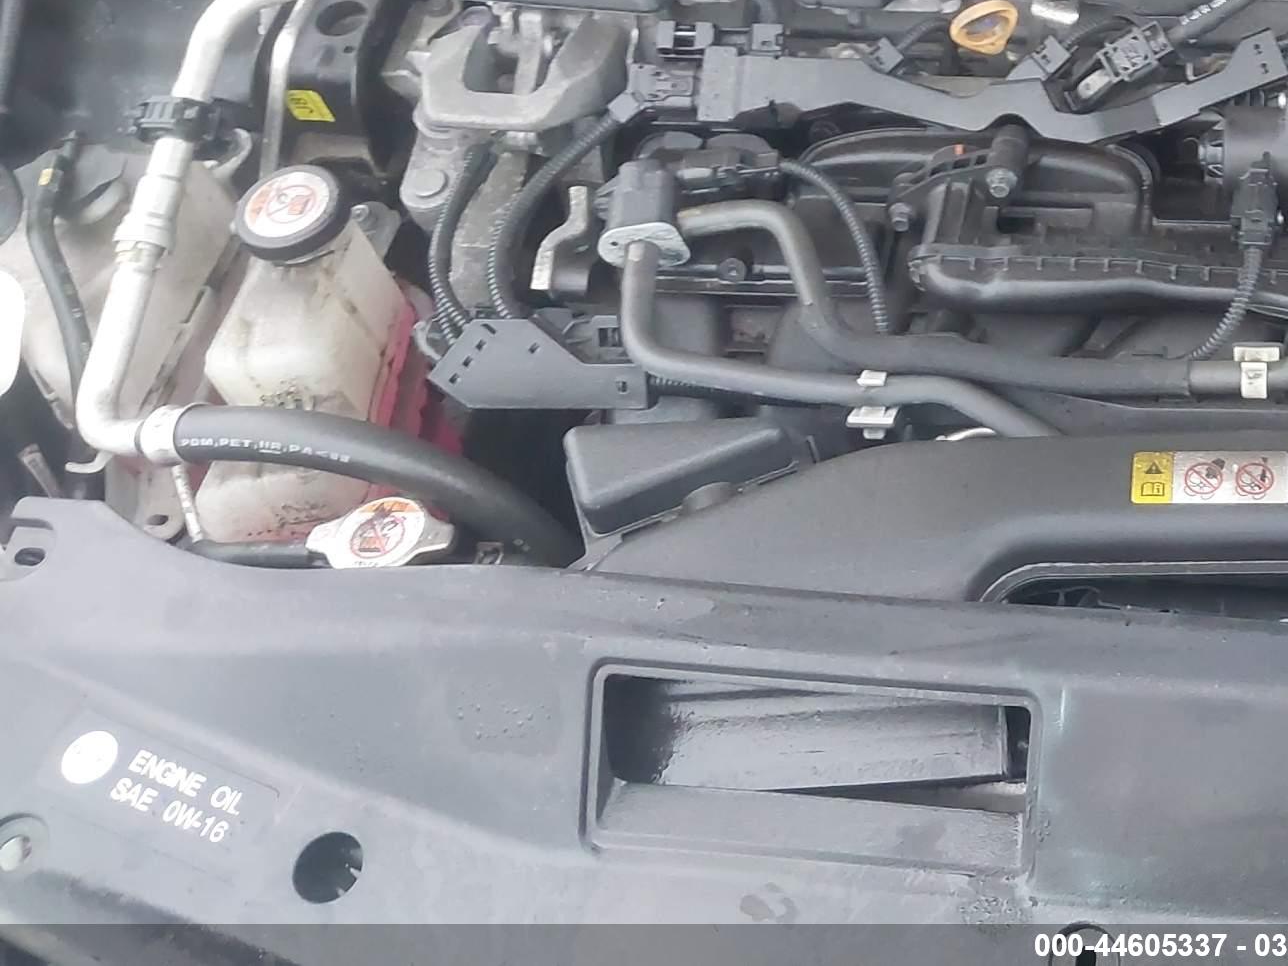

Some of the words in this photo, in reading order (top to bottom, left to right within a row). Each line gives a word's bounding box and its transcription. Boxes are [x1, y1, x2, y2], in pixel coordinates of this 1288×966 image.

[110, 777, 158, 812] SAE
[162, 800, 229, 842] 0W-16
[128, 749, 206, 797] ENGINE
[210, 785, 242, 815] OIL
